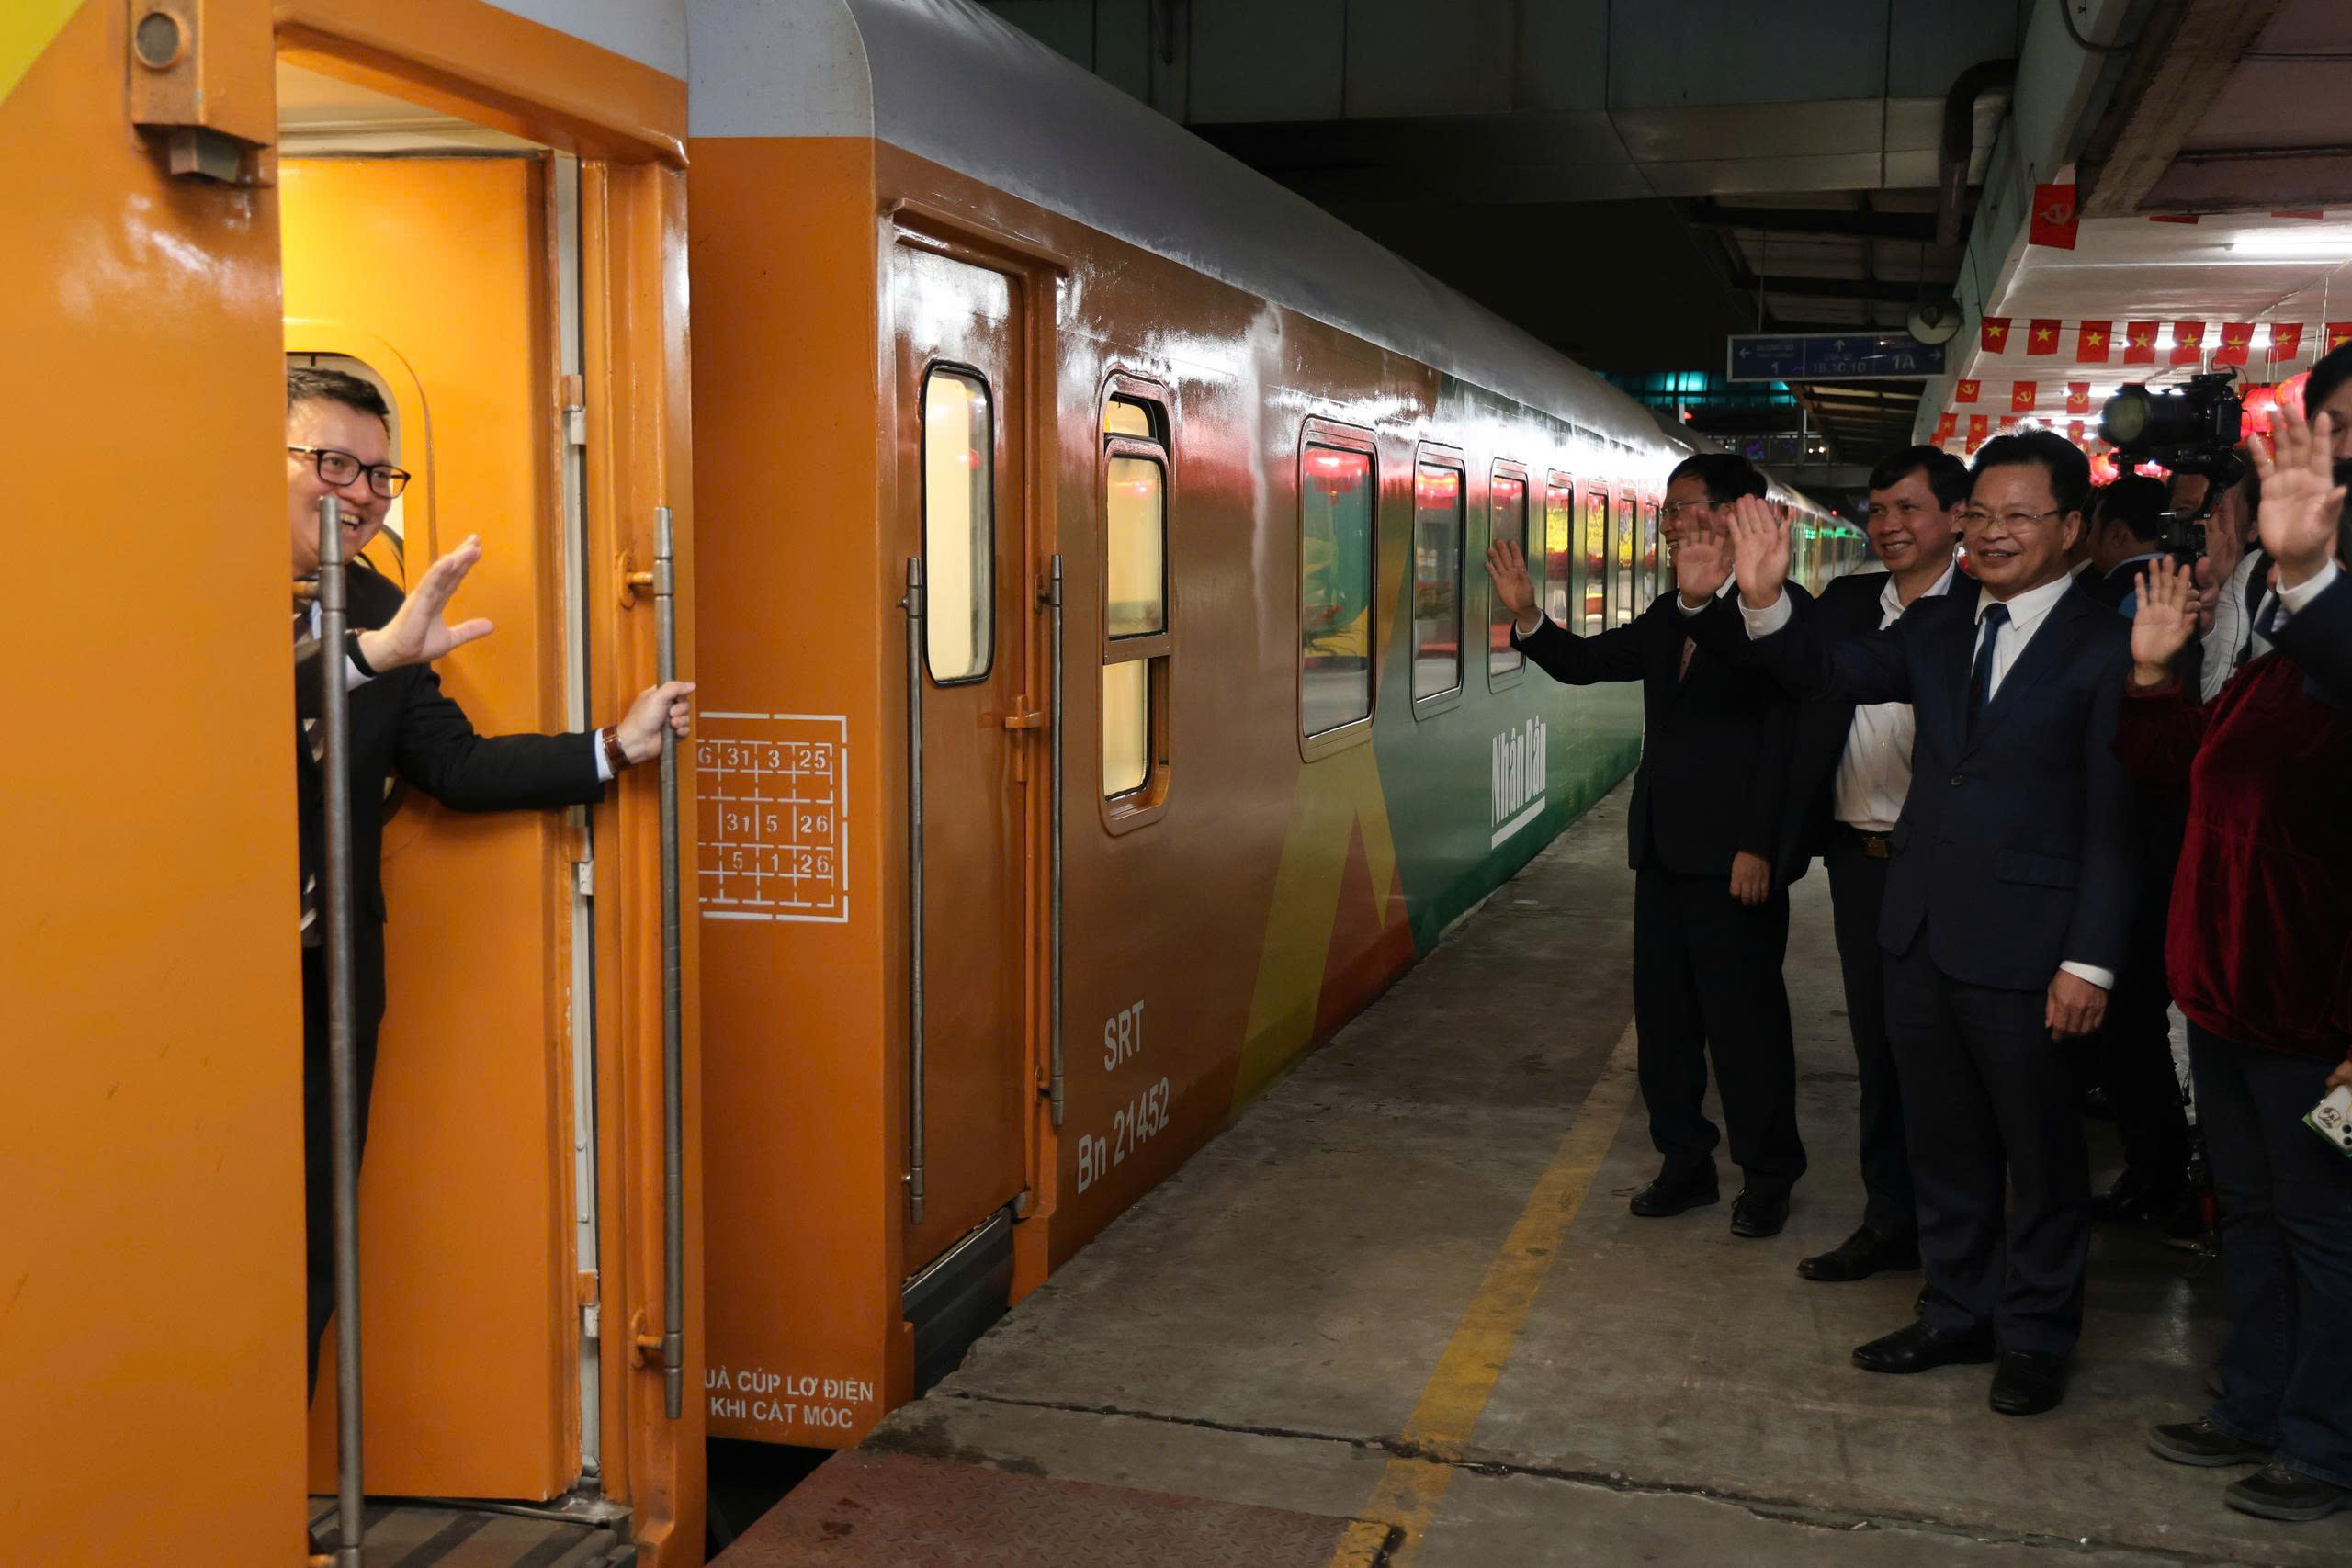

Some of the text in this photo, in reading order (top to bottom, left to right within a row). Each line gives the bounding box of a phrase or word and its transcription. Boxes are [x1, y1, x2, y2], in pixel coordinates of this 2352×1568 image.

[1893, 354, 1916, 370] 1A
[727, 747, 750, 765] 31
[767, 749, 780, 768] 3
[799, 749, 826, 769] 25
[1491, 715, 1546, 828] Nhân Dân
[726, 813, 829, 833] 31 5 26
[732, 852, 829, 874] 5 1 26
[1103, 999, 1145, 1072] SRT
[1078, 1077, 1170, 1195] Bn 21452
[737, 1367, 782, 1393] CÚP
[823, 1377, 874, 1406] ĐIỆN
[710, 1396, 746, 1419] KHI
